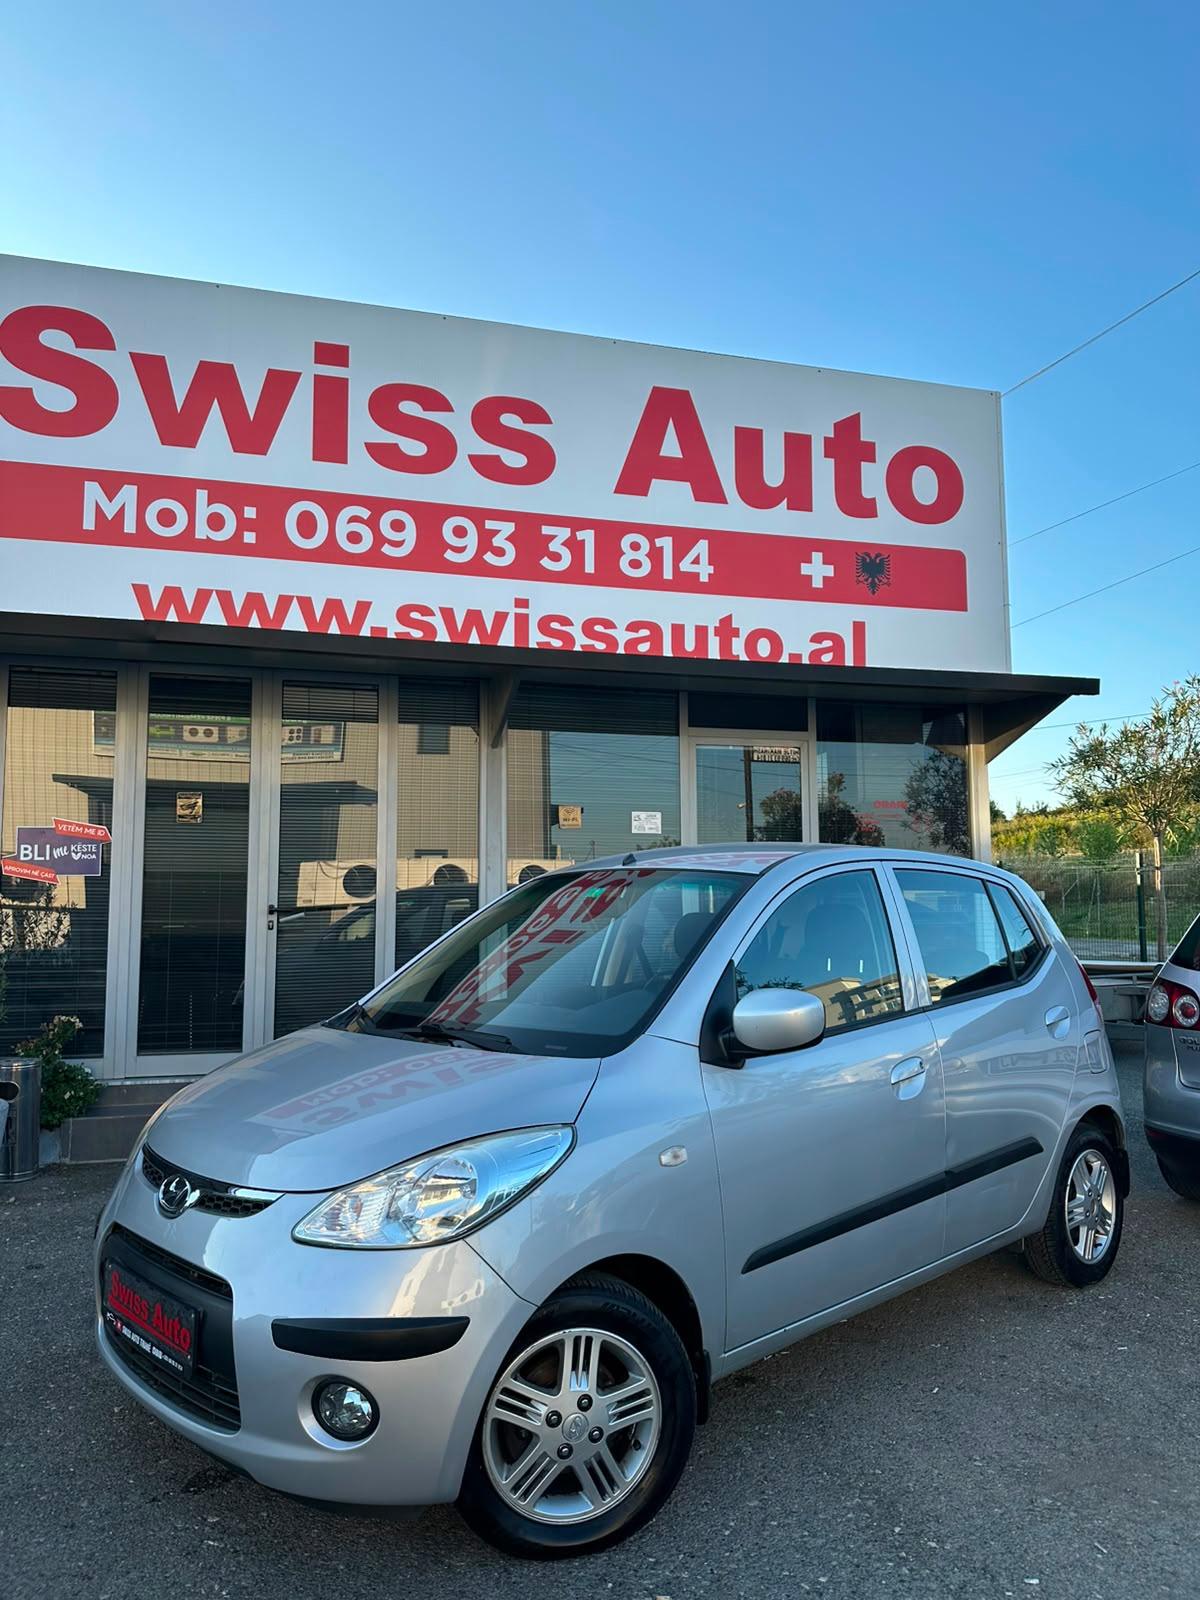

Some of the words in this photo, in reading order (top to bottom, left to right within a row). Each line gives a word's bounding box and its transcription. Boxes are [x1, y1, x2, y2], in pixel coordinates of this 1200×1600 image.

[0, 305, 557, 486] Swiss
[613, 385, 965, 525] Auto
[82, 481, 257, 544] Mob:
[284, 500, 417, 558] 069
[441, 516, 517, 568] 93
[539, 526, 596, 574] 31
[618, 532, 714, 583] 814
[131, 582, 867, 668] www.swissauto.al
[20, 844, 50, 861] BLI
[53, 846, 70, 859] me
[84, 827, 96, 835] ME
[152, 1303, 191, 1351] Auto
